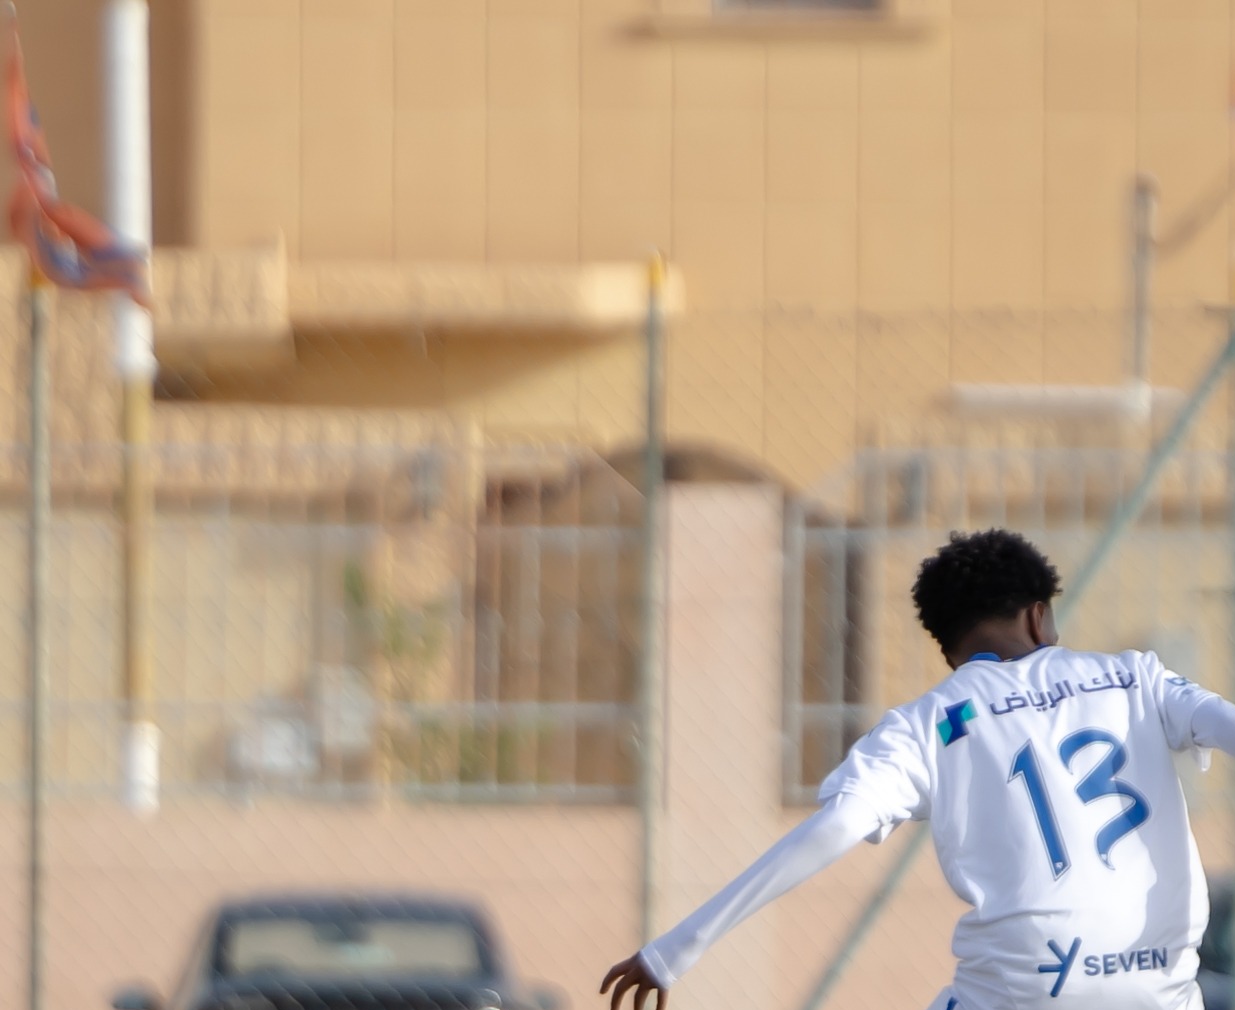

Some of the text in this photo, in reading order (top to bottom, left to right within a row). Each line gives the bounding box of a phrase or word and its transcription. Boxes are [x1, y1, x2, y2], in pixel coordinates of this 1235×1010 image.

[990, 671, 1139, 716] بنك الرياض
[1007, 727, 1151, 881] 13
[1083, 947, 1168, 976] SEVEN
